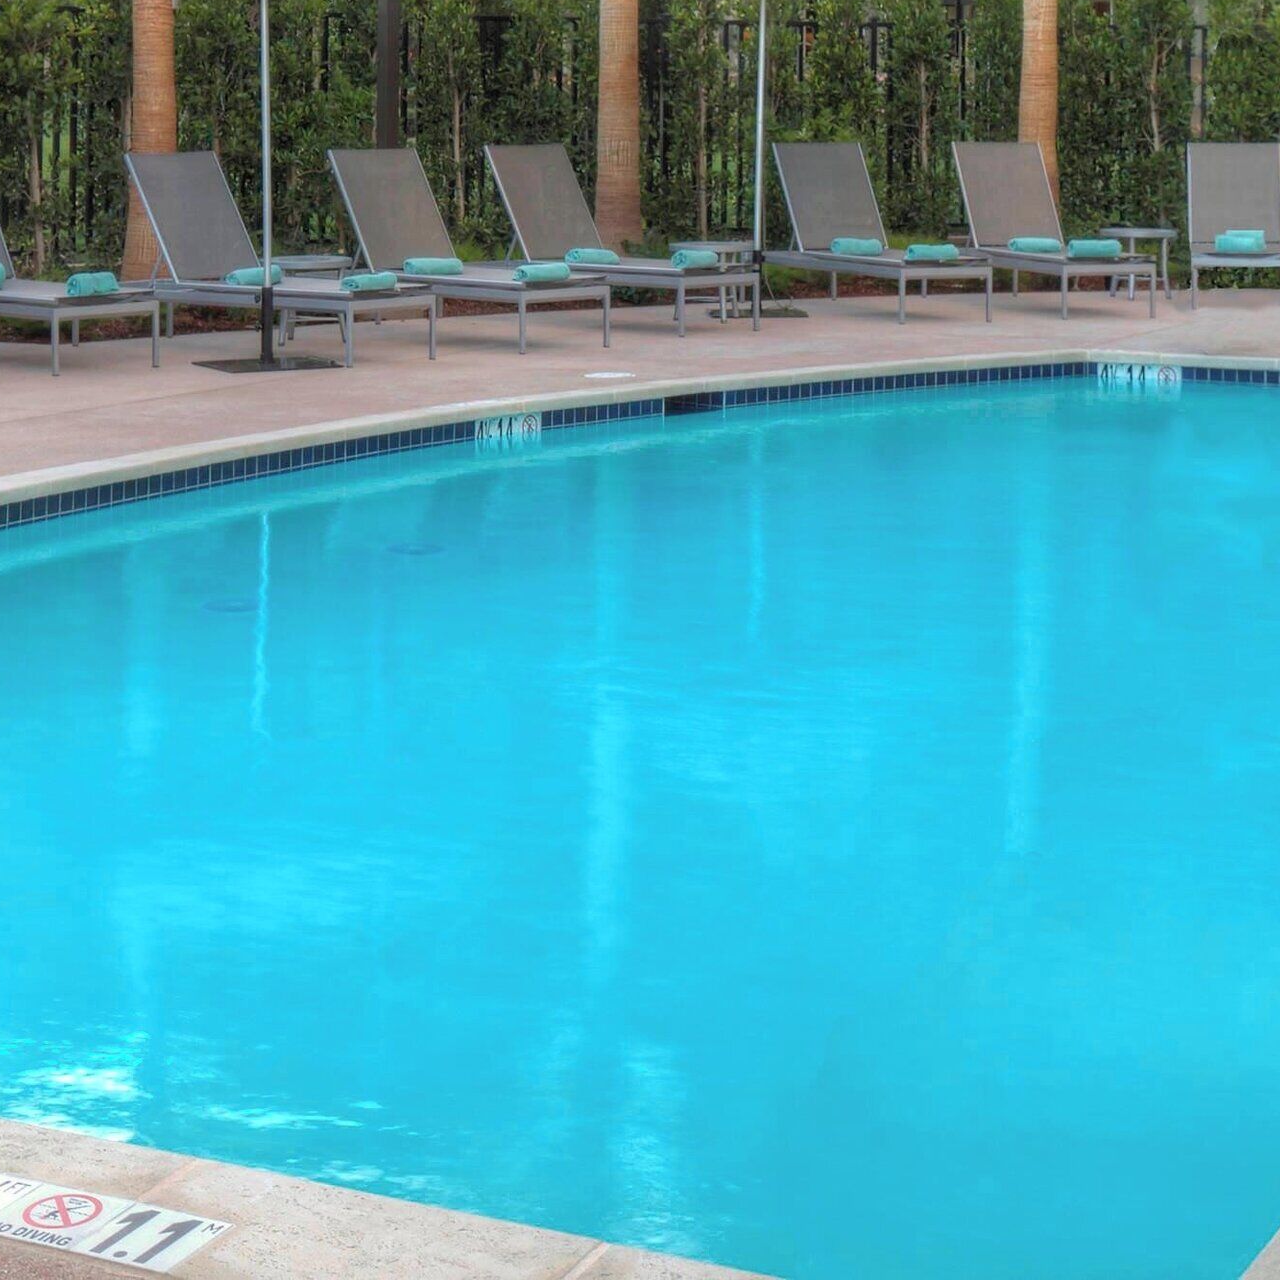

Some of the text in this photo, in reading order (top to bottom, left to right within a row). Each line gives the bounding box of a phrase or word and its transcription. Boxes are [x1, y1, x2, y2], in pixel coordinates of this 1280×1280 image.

[3, 1182, 32, 1195] FT
[12, 1226, 72, 1246] DIVING
[89, 1209, 225, 1264] 1.1 M
